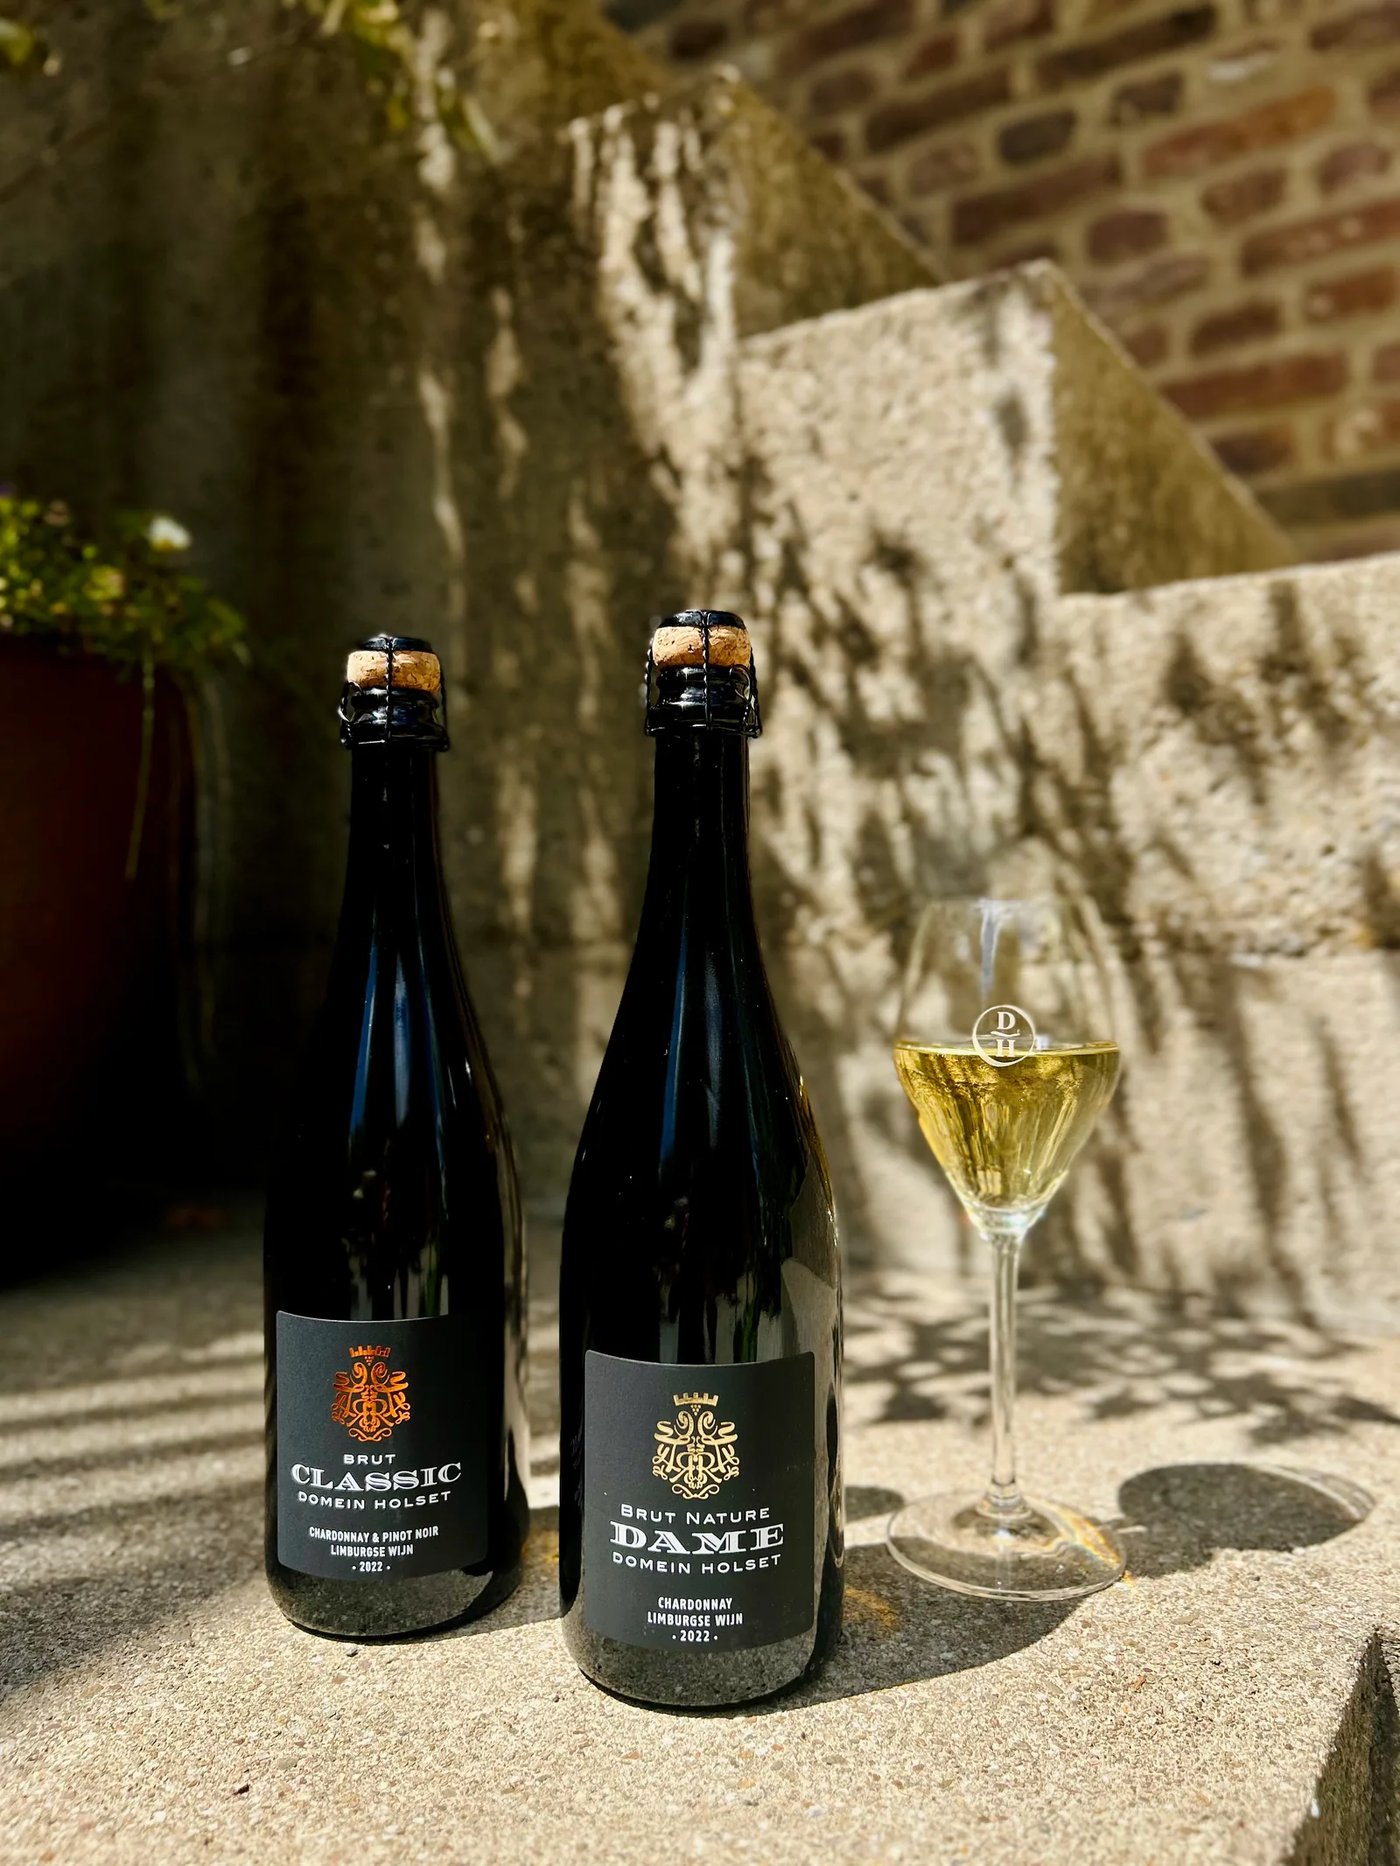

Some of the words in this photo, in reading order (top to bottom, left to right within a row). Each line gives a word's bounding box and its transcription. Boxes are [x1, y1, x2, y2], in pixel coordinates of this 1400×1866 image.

[996, 1011, 1016, 1030] D
[996, 1038, 1016, 1058] H
[343, 1453, 396, 1465] BRUT
[291, 1462, 462, 1492] CLASSIC
[298, 1490, 365, 1510] DOMEIN
[374, 1490, 451, 1509] HOLSET
[621, 1503, 676, 1524] BRUT
[686, 1507, 770, 1525] NATURE
[309, 1526, 370, 1543] CHARDONNAY
[372, 1531, 380, 1542] &
[382, 1530, 413, 1543] PINOT
[415, 1525, 439, 1540] NOIR
[610, 1520, 784, 1555] DAME
[330, 1544, 385, 1557] LIMBURGSE
[388, 1544, 414, 1556] WIJN
[612, 1551, 691, 1574] DOMEIN
[701, 1554, 781, 1574] HOLSET
[658, 1597, 733, 1612] CHARDONNAY
[647, 1611, 711, 1627] LIMBURGSE
[715, 1612, 743, 1626] WIJN
